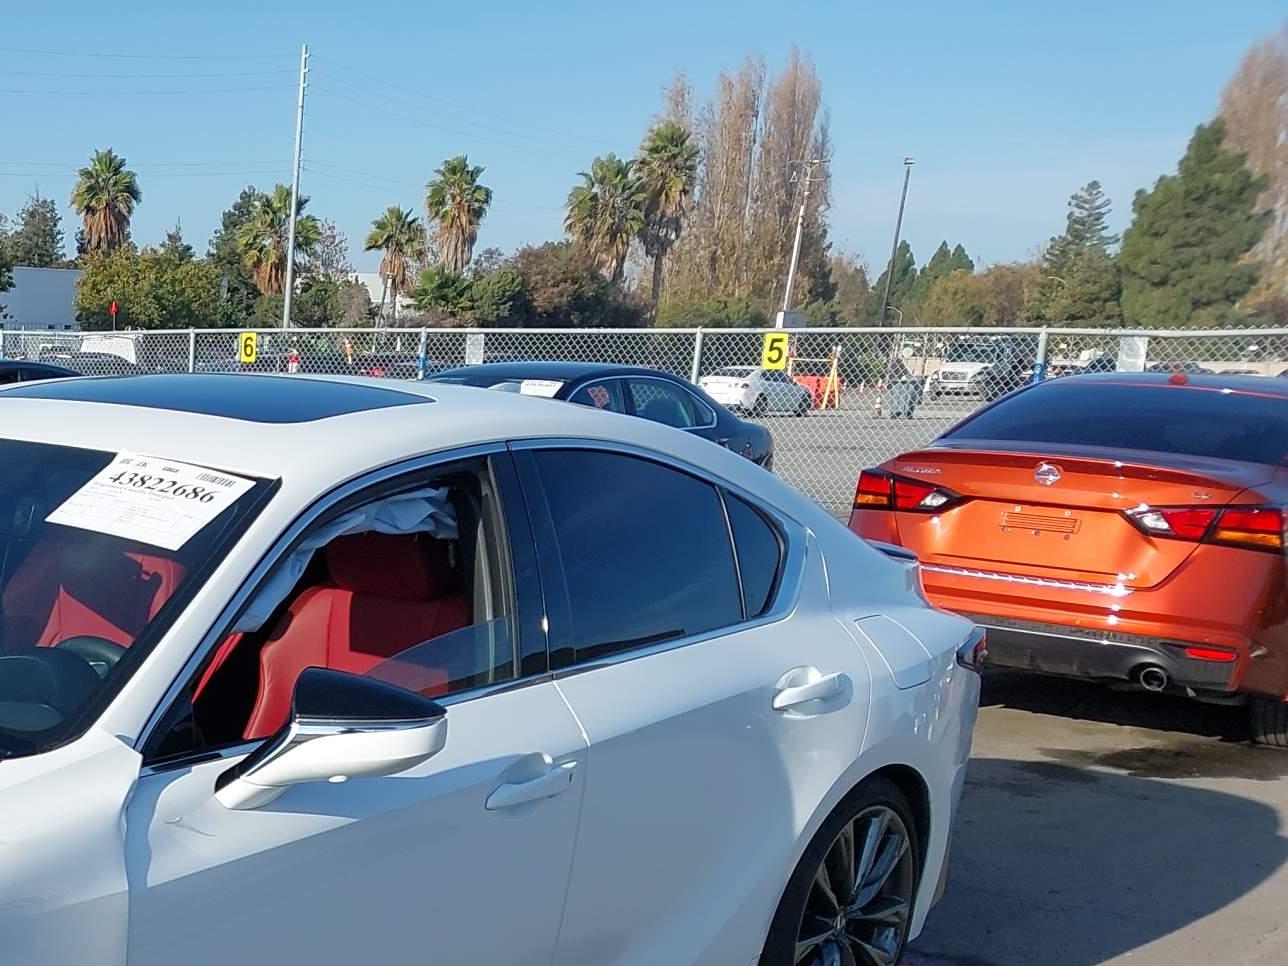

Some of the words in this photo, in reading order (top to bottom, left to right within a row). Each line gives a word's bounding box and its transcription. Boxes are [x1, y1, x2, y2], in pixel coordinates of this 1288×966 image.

[244, 336, 253, 357] 6
[767, 337, 784, 364] 5
[109, 470, 221, 503] 43822686
